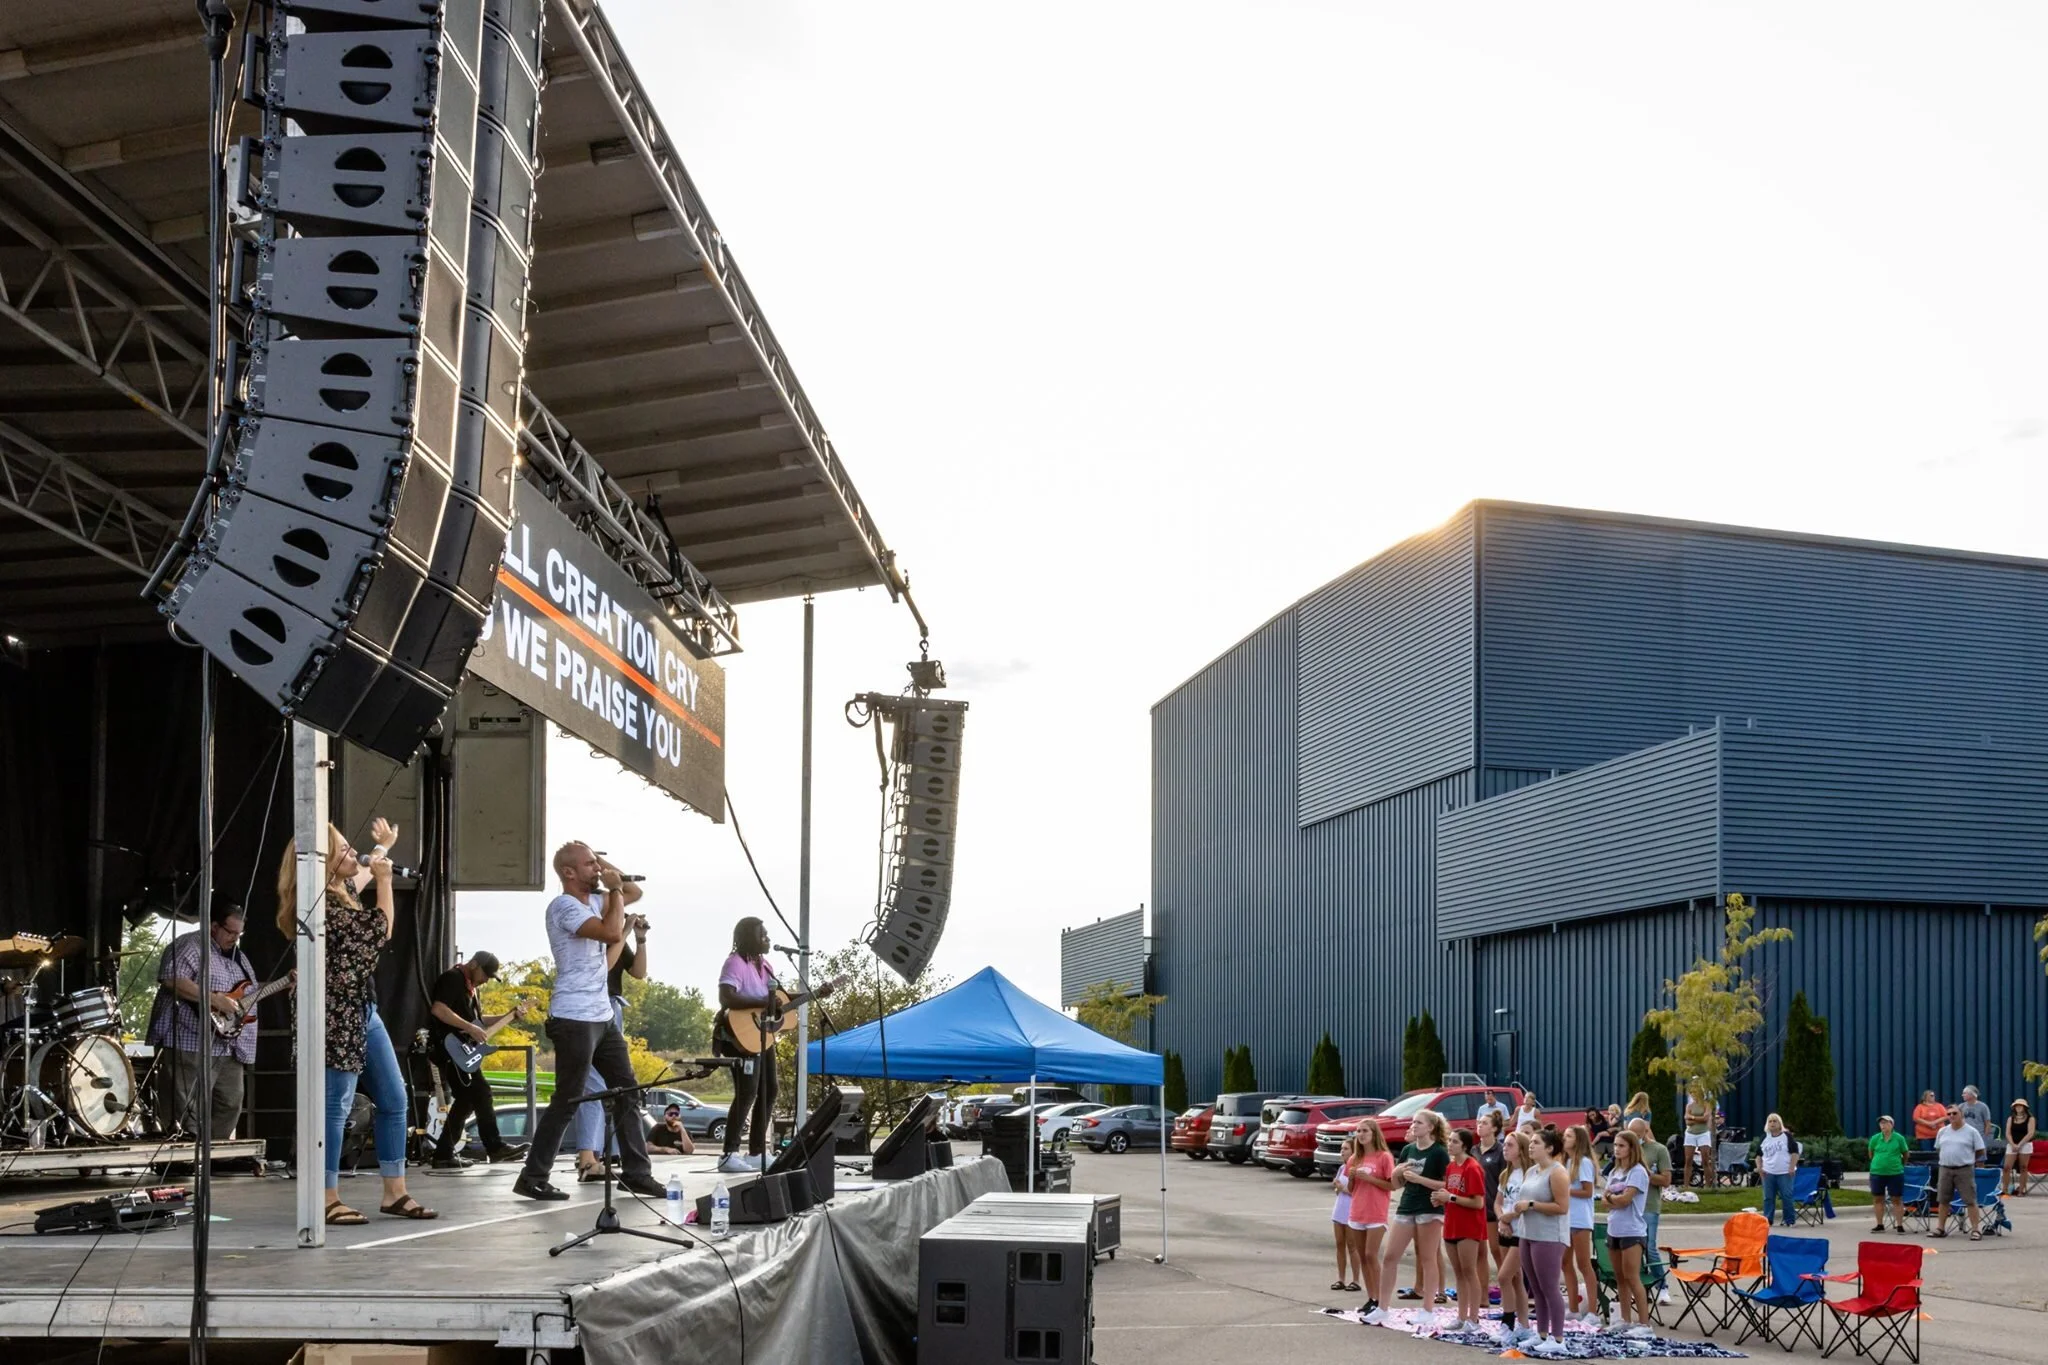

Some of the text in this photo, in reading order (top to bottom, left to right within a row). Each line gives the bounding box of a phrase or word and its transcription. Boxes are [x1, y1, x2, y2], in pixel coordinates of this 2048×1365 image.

[502, 599, 548, 681] WE
[555, 638, 638, 741] PRAISE
[642, 701, 681, 768] YOU
[503, 523, 540, 588] LL
[546, 548, 660, 682] CREATION
[664, 650, 699, 712] CRY
